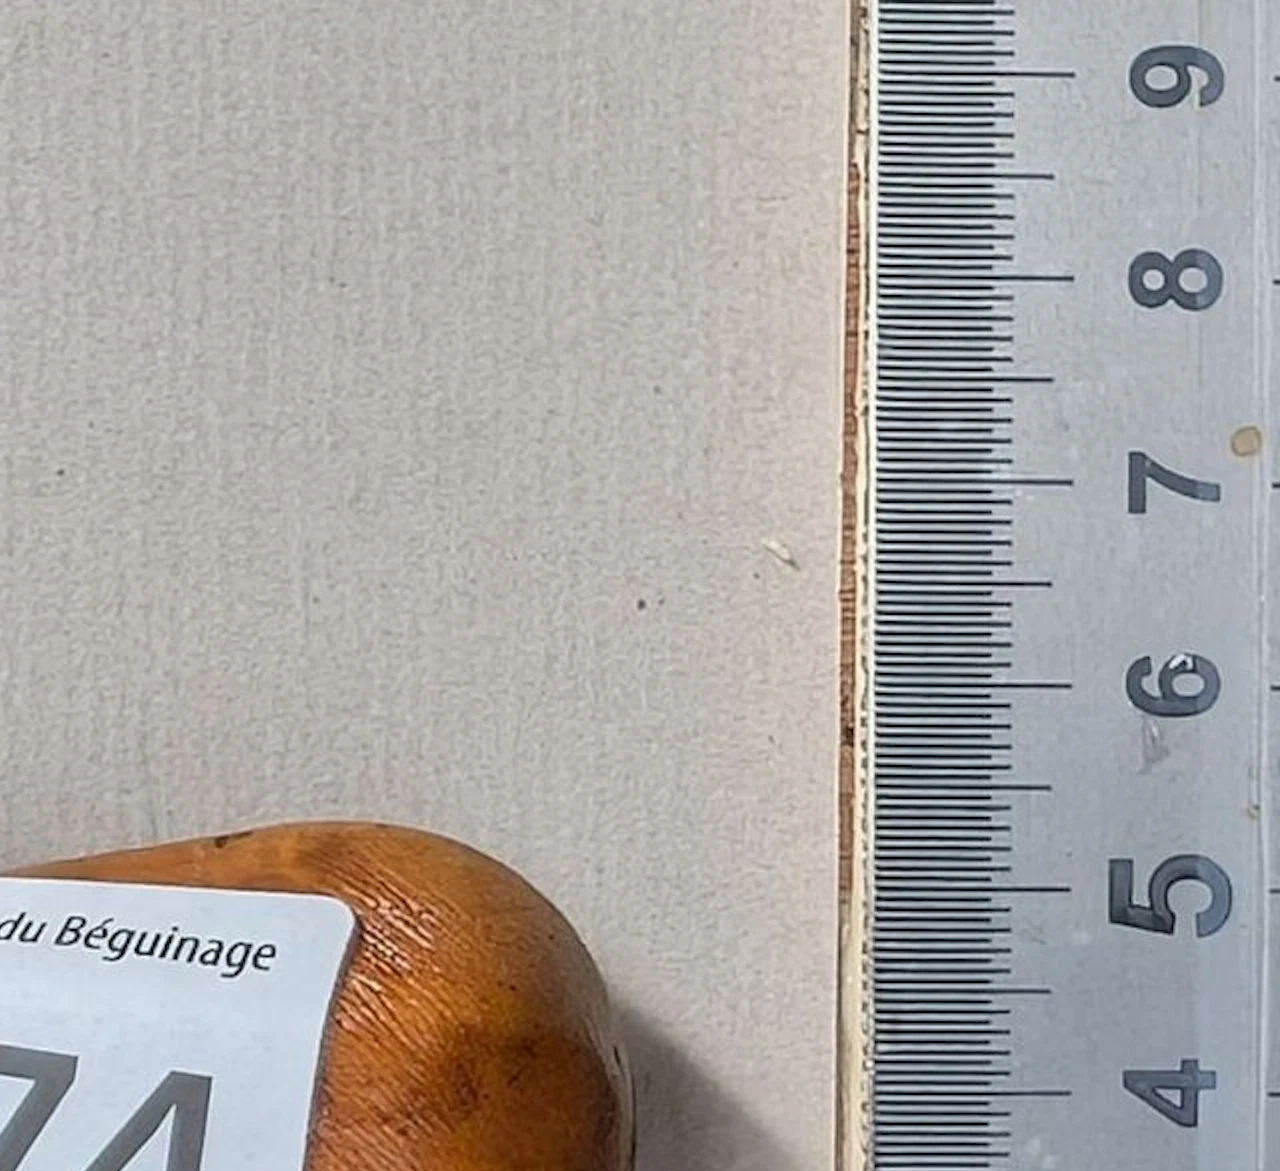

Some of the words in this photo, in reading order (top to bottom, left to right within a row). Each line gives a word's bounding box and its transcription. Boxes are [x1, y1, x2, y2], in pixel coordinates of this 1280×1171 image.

[1129, 45, 1225, 109] 9
[1128, 248, 1224, 312] 8
[1127, 451, 1221, 515] 7
[1125, 653, 1221, 719] 6
[1108, 853, 1233, 939] 5
[54, 914, 278, 979] Béguinage
[1122, 1058, 1217, 1128] 4
